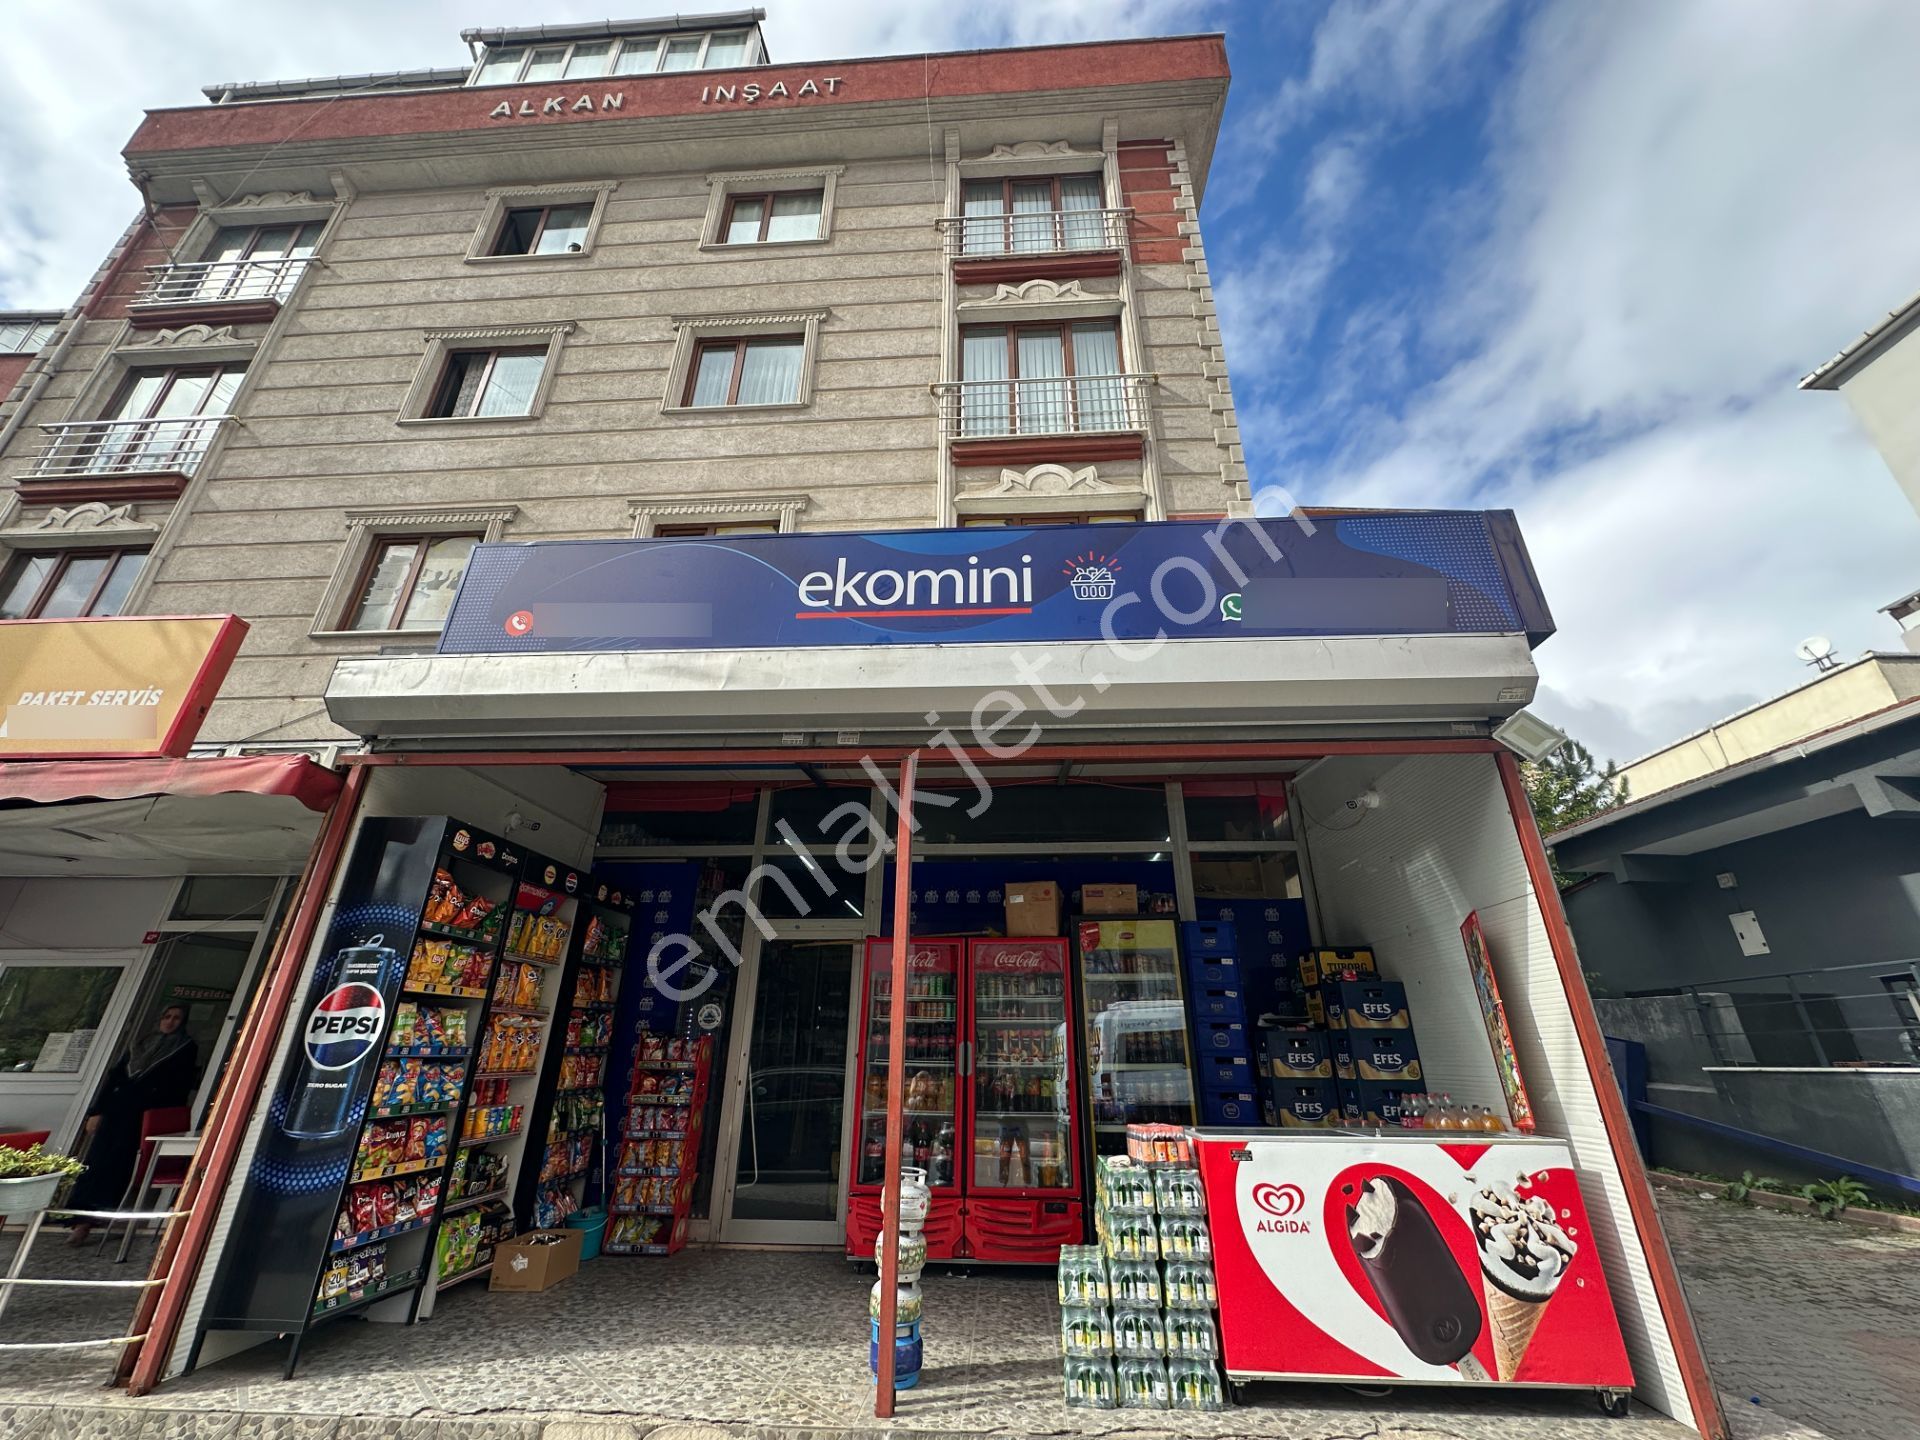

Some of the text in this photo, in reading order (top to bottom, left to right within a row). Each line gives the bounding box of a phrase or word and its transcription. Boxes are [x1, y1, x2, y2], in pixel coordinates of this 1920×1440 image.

[489, 92, 624, 118] ALKAN
[799, 555, 1032, 607] ekomini
[17, 685, 164, 706] PAKET SERVİS
[1363, 1003, 1391, 1014] EFES
[310, 1017, 380, 1034] PEPSI
[1287, 1053, 1315, 1063] EFES
[1373, 1053, 1402, 1065] EFES
[1295, 1103, 1323, 1113] EFES
[1383, 1105, 1401, 1117] EF
